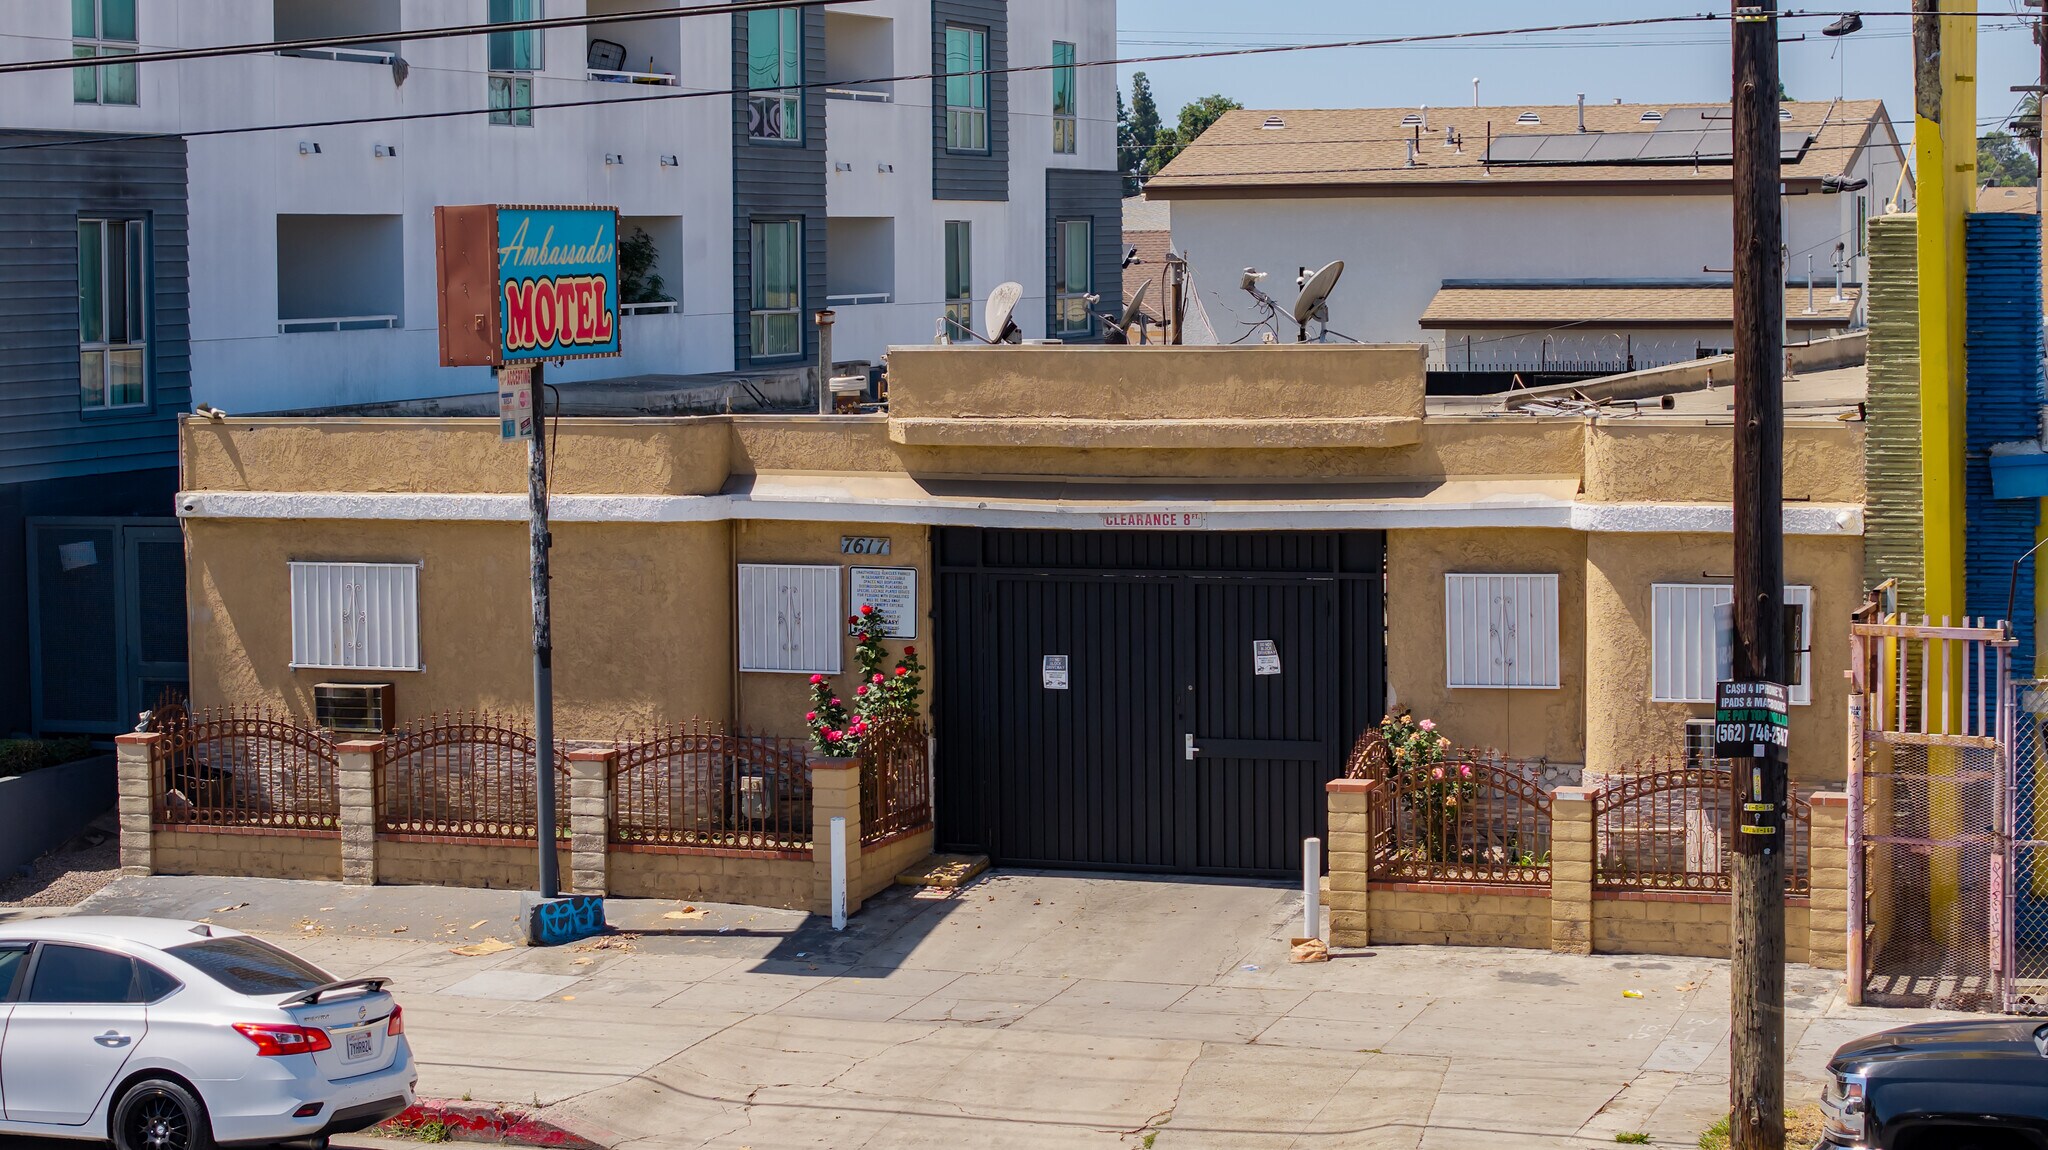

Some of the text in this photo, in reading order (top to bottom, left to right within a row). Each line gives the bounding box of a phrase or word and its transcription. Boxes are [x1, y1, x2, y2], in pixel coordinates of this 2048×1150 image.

[501, 217, 614, 266] Ambassador
[505, 276, 612, 350] MOTEL
[507, 369, 530, 385] ACCEPTING
[1106, 513, 1177, 526] CLEARANCE
[1183, 513, 1191, 526] 8
[843, 537, 888, 554] 7617
[1725, 683, 1746, 694] CA$H
[1748, 684, 1753, 693] 4
[1721, 697, 1744, 707] IPADS
[1746, 697, 1752, 707] &
[1717, 710, 1730, 721] WE
[1732, 710, 1749, 721] PAY
[1750, 710, 1767, 721] TOP
[1716, 723, 1745, 743] (562)
